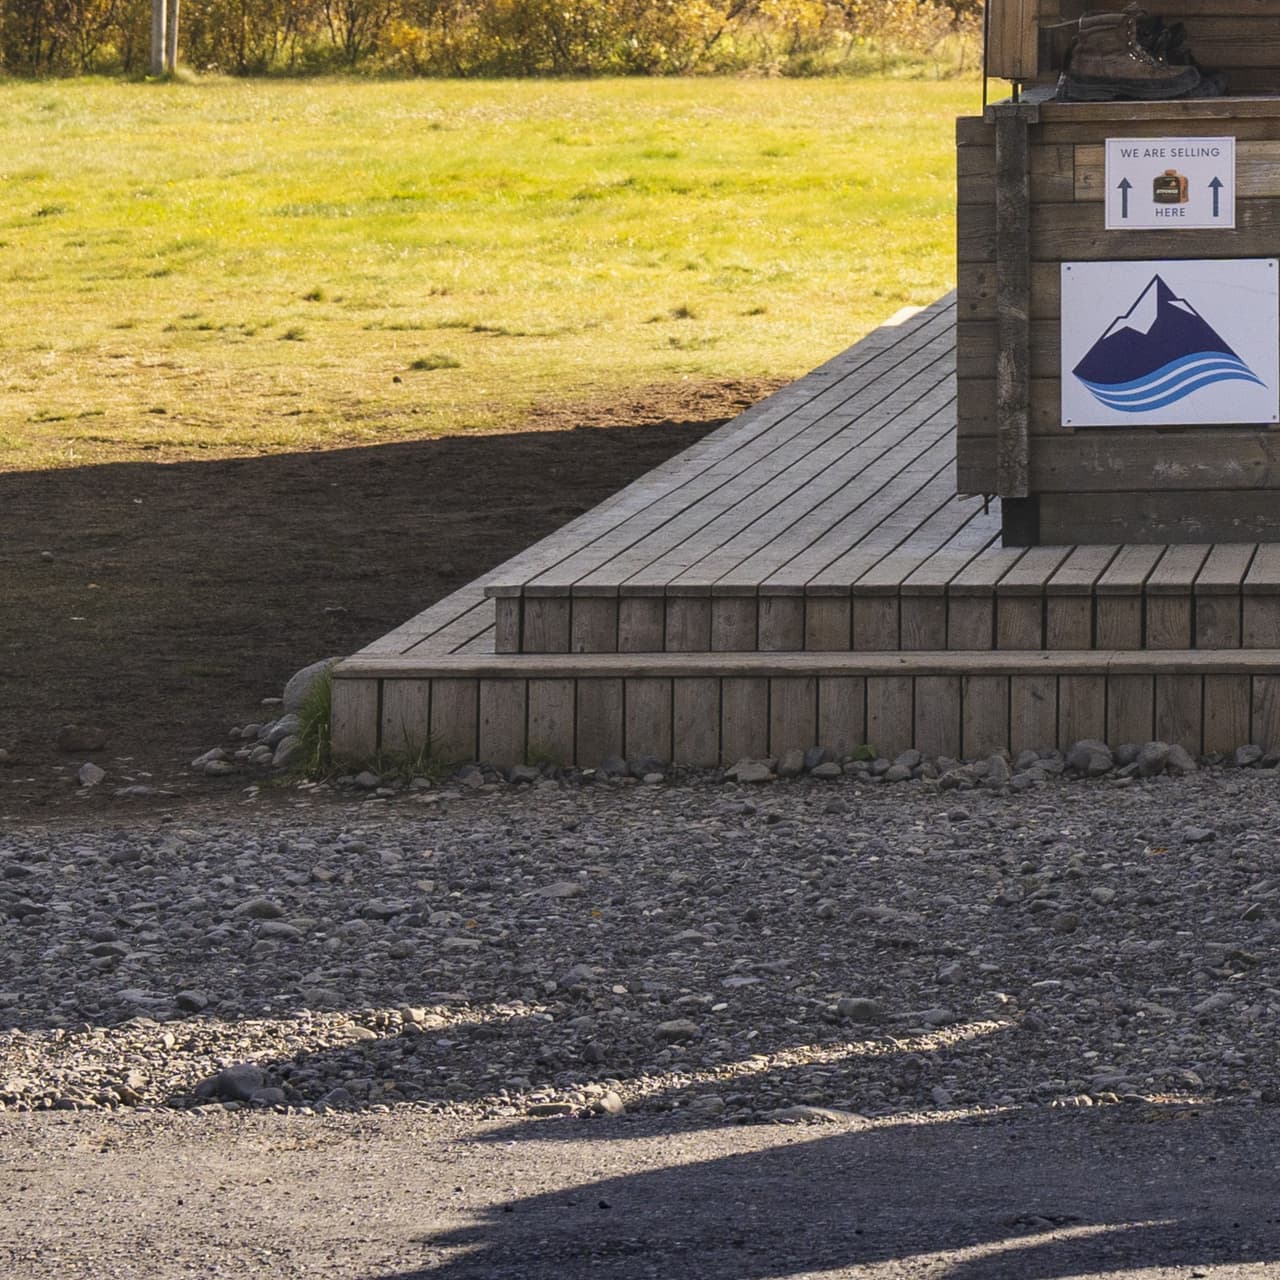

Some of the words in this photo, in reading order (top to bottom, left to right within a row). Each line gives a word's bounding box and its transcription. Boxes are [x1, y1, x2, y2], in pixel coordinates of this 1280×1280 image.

[1120, 148, 1139, 158] WE
[1143, 148, 1166, 158] ARE
[1170, 147, 1220, 157] SELLING
[1155, 207, 1186, 217] HERE
